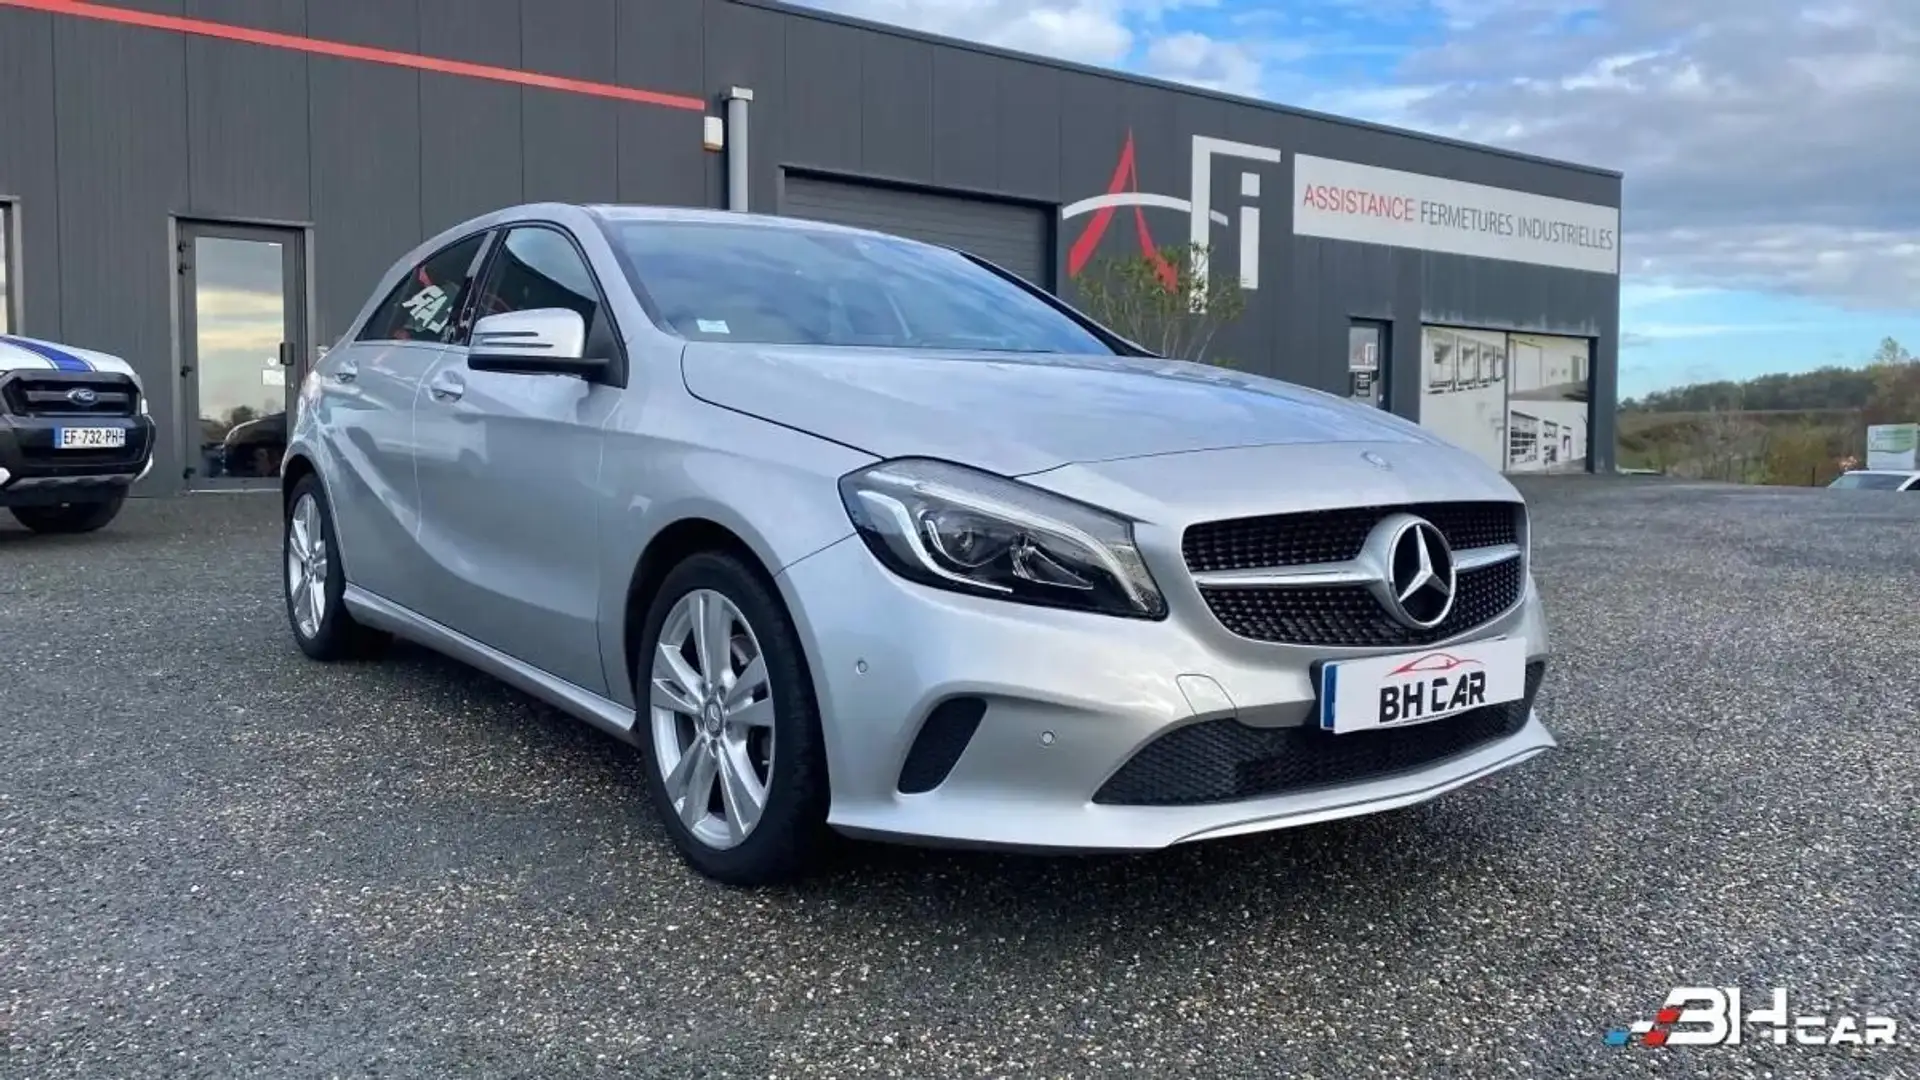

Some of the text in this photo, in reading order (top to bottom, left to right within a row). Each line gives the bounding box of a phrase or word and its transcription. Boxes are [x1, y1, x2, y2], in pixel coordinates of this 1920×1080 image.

[1303, 183, 1614, 251] ASSISTANCE FERMETURES INDUSTRIELLES
[1378, 670, 1486, 723] BH CAR
